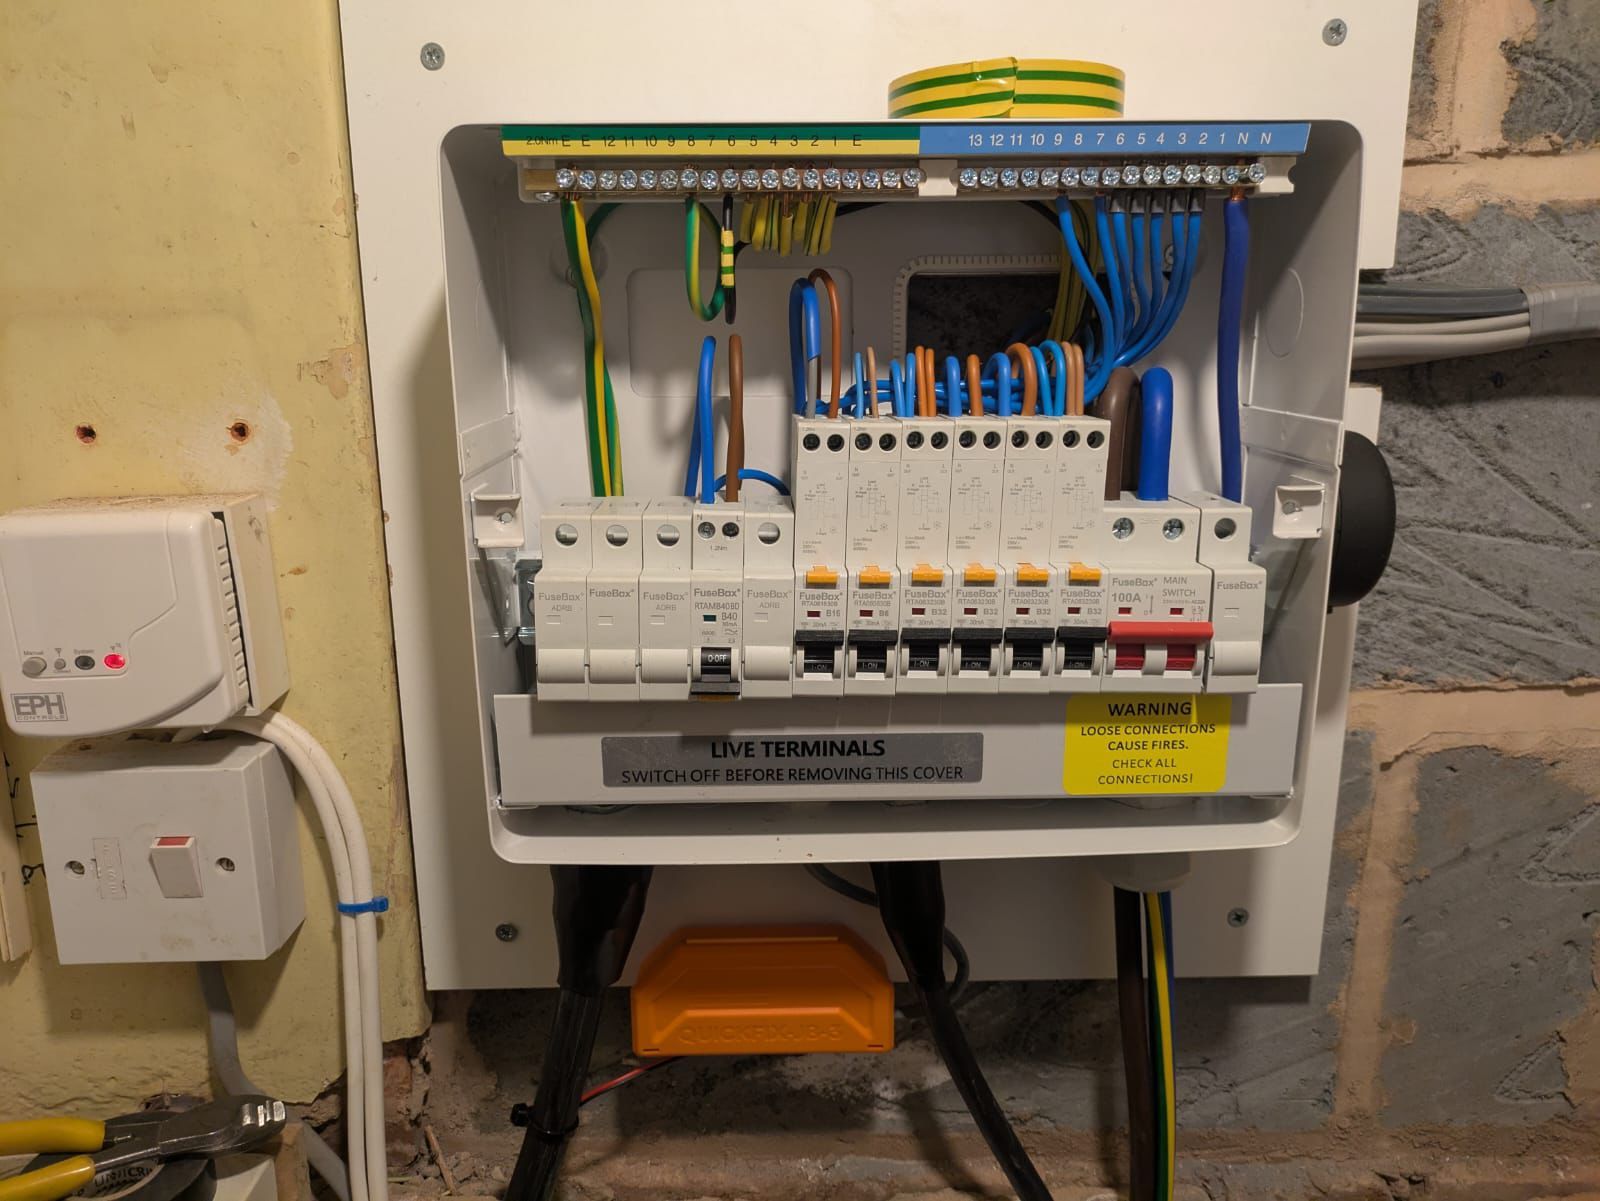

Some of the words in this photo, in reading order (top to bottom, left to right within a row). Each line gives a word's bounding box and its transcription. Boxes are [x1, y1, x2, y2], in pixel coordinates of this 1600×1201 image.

[561, 134, 571, 146] E
[582, 134, 591, 146] E
[603, 134, 616, 146] 12
[624, 134, 636, 146] 11
[645, 134, 658, 146] 10
[667, 134, 675, 146] 9
[688, 134, 696, 146] 8
[709, 134, 716, 146] 7
[728, 134, 736, 146] 6
[750, 134, 758, 146] 5
[770, 134, 778, 146] 4
[790, 134, 799, 146] 3
[811, 134, 819, 146] 2
[833, 134, 837, 146] 1
[853, 134, 862, 146] E
[968, 134, 983, 147] 13
[990, 134, 1004, 146] 12
[1010, 134, 1023, 146] 11
[1030, 133, 1045, 146] 10
[1054, 133, 1063, 145] 9
[1074, 133, 1083, 145] 8
[1097, 133, 1104, 145] 7
[1116, 133, 1125, 145] 6
[1137, 133, 1146, 145] 5
[1156, 133, 1165, 145] 4
[1177, 133, 1187, 145] 3
[1199, 132, 1208, 145] 2
[1219, 132, 1226, 145] 1
[1237, 132, 1249, 145] N
[1260, 132, 1272, 145] N
[1163, 576, 1188, 584] MAIN
[1112, 593, 1142, 602] 100A
[1162, 589, 1196, 597] SWITCH
[721, 612, 738, 620] B40
[14, 694, 64, 715] EPH
[1108, 702, 1192, 717] WARNING
[1081, 725, 1121, 736] LOOSE
[1124, 723, 1216, 735] CONNECTIONS
[711, 741, 755, 758] LIVE
[761, 740, 885, 758] TERMINALS
[1108, 740, 1149, 751] CAUSE
[1151, 740, 1189, 750] FIRES.
[1112, 759, 1153, 769] CHECK
[1155, 758, 1177, 768] ALL
[622, 770, 686, 783] SWITCH
[690, 769, 721, 782] OFF
[726, 768, 784, 782] BEFORE
[788, 768, 872, 781] REMOVING
[876, 767, 908, 780] THIS
[913, 766, 963, 779] COVER
[1098, 773, 1193, 785] CONNECTIONS!
